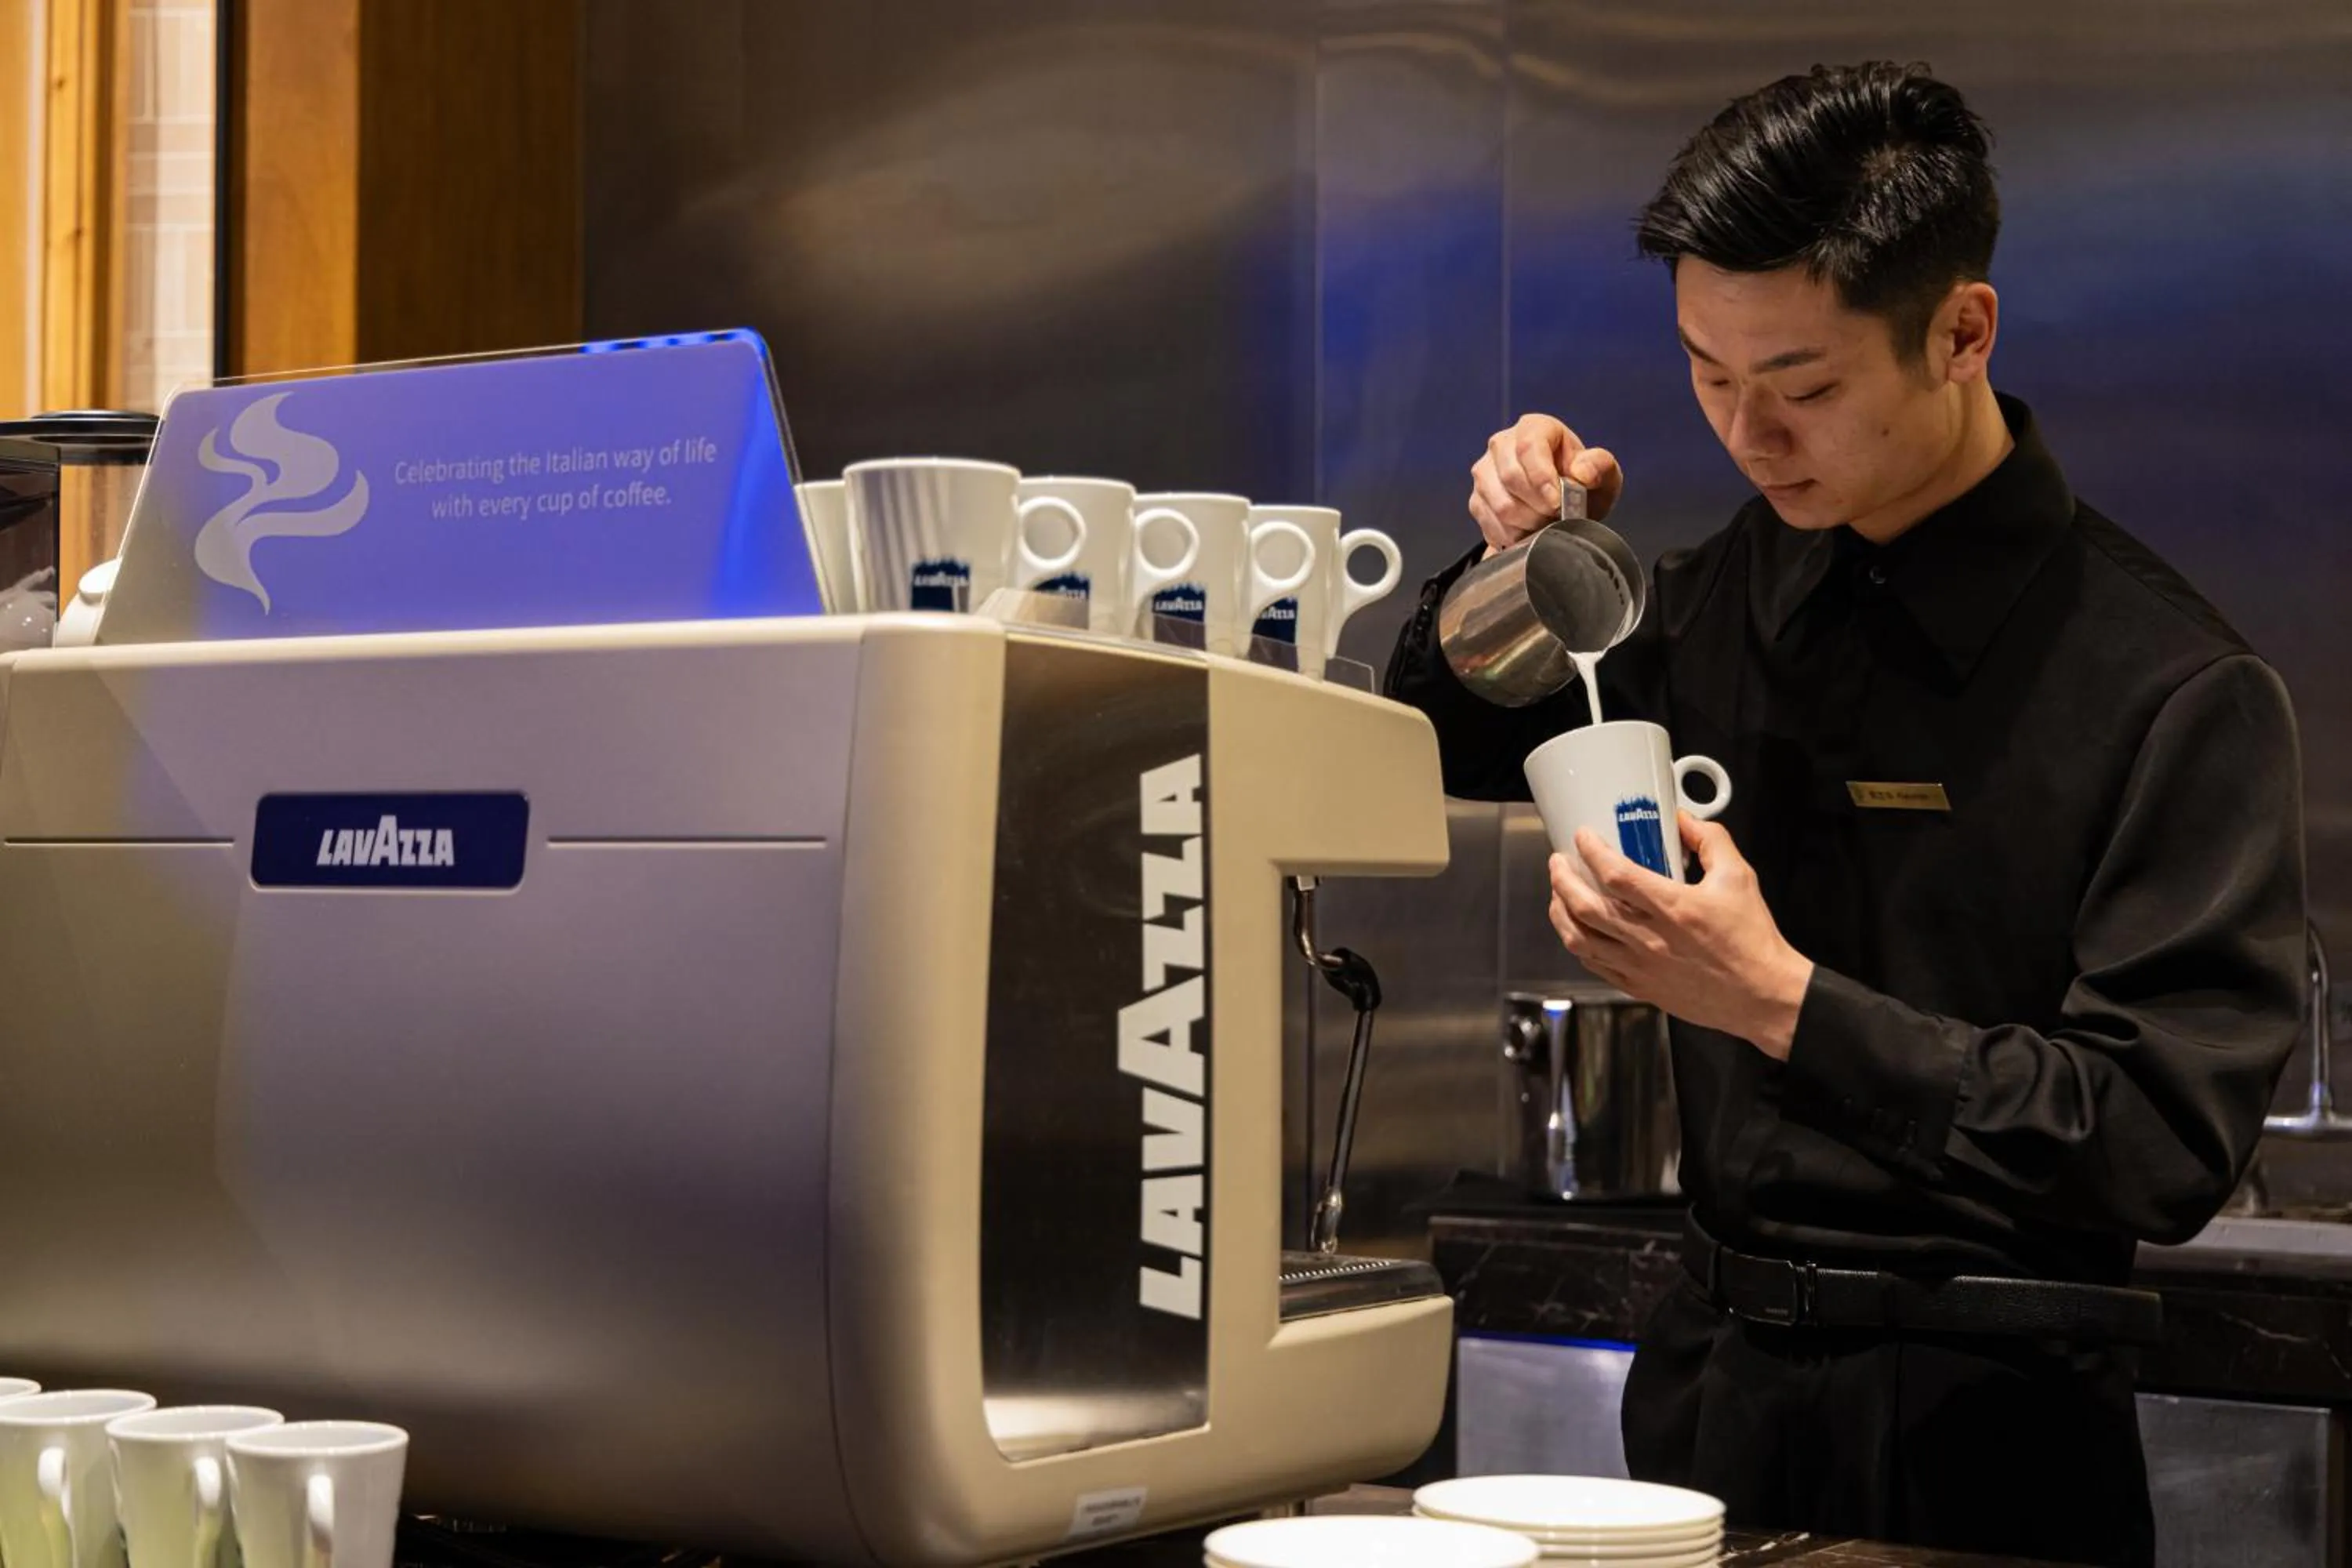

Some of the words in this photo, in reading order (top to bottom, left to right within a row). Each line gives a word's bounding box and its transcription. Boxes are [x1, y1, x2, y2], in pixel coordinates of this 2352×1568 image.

[395, 457, 504, 485] Celebrating
[509, 452, 540, 476] the
[546, 447, 608, 474] Italian
[614, 448, 654, 474] way
[659, 439, 681, 466] of
[685, 437, 717, 464] life
[431, 493, 473, 519] with
[479, 495, 532, 521] every
[537, 493, 573, 516] cup
[579, 484, 601, 510] of
[604, 481, 672, 509] coffee.
[1155, 597, 1204, 612] LAVAZZA
[1618, 807, 1660, 822] LAVAZZA
[316, 815, 454, 866] LAVAZZA
[1117, 753, 1205, 1320] LAVAZZA
